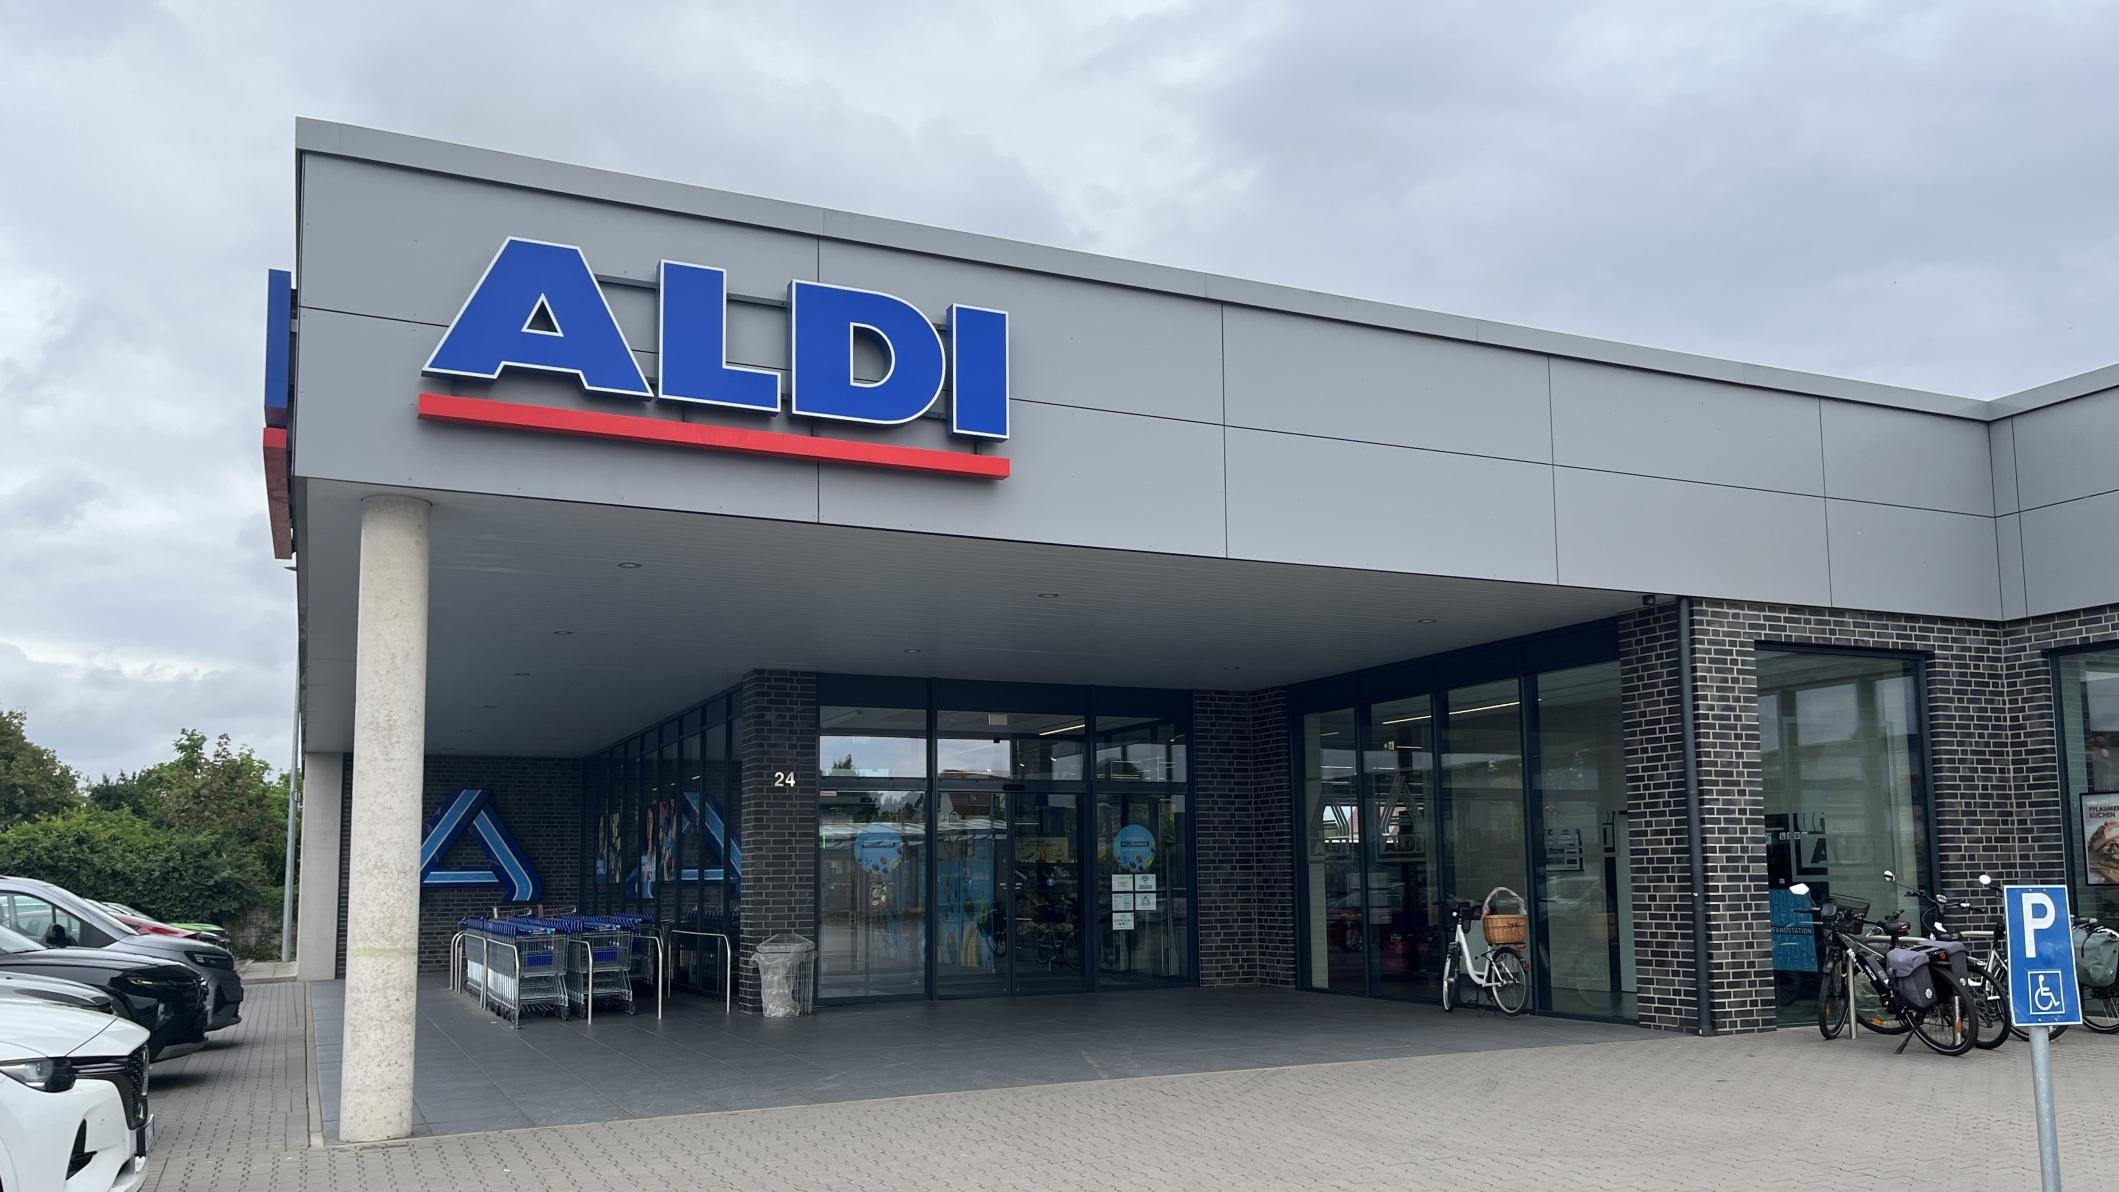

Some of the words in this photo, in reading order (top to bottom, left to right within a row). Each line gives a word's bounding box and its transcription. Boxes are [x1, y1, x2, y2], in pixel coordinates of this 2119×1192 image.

[420, 235, 1010, 442] ALDI
[774, 771, 796, 787] 24
[2021, 892, 2056, 959] P
